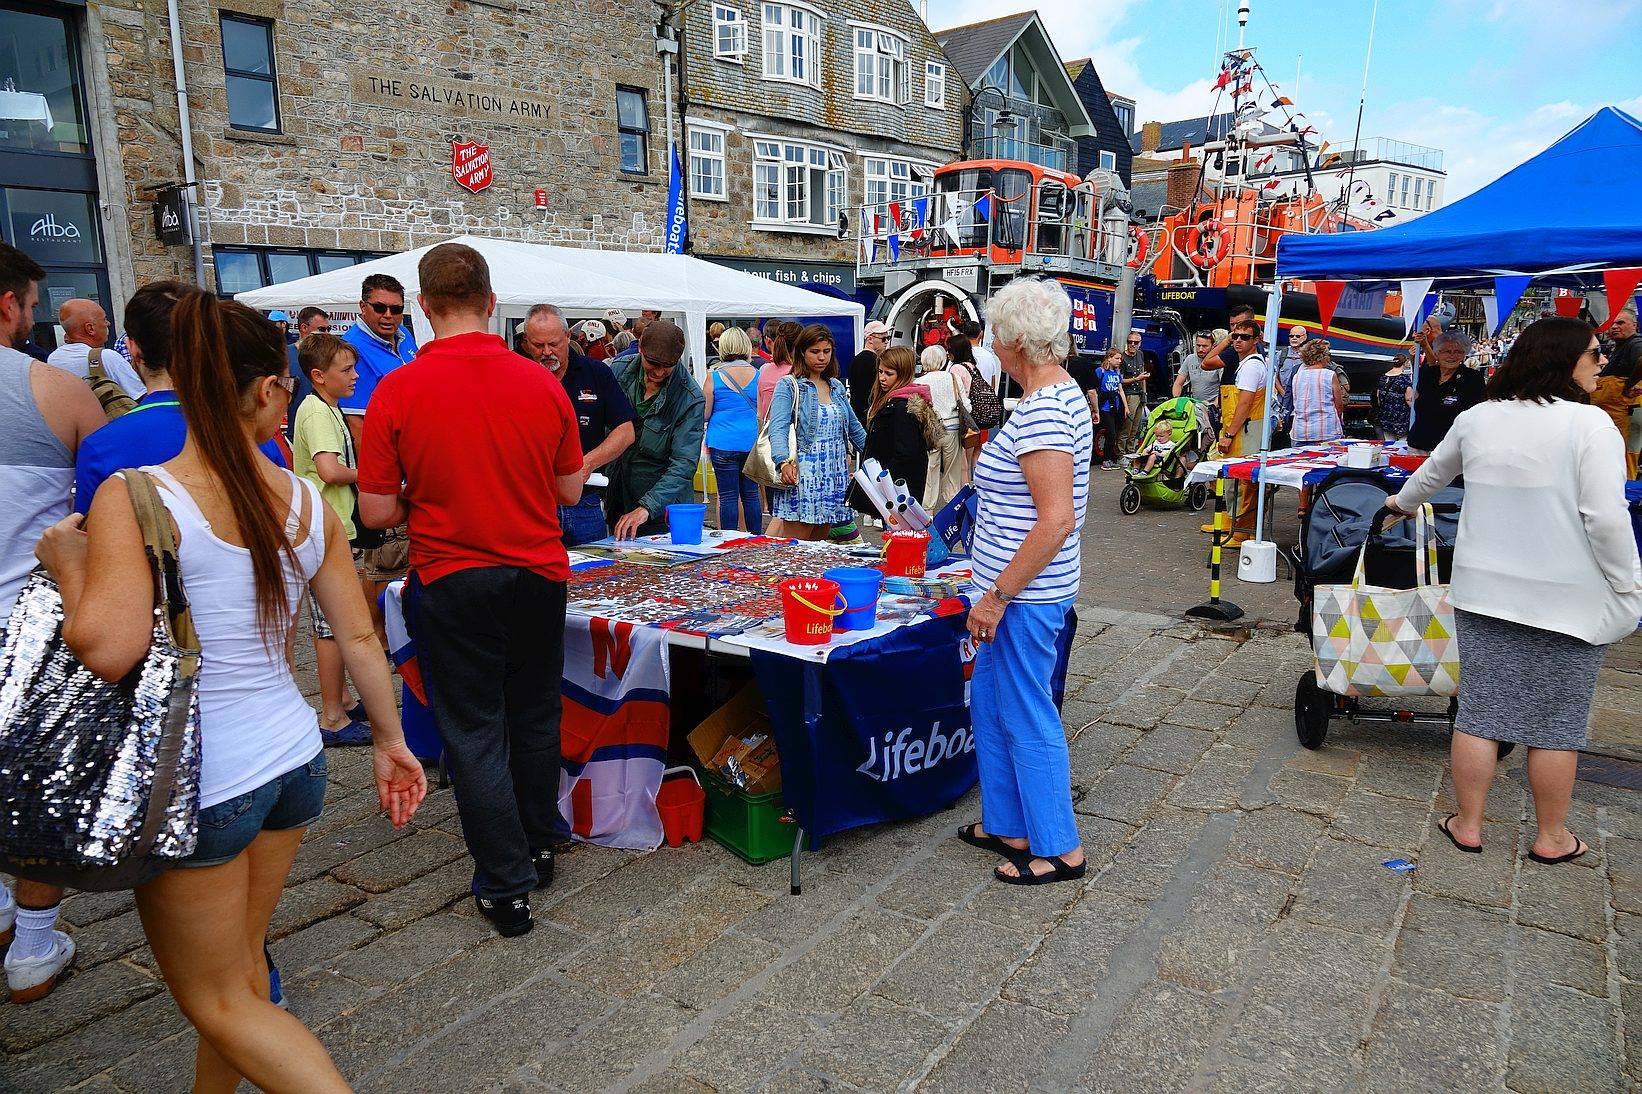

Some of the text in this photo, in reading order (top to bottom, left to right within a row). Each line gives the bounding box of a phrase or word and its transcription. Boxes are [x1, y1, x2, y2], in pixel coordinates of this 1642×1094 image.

[368, 77, 551, 119] THE SALVATION ARMY
[459, 146, 477, 161] THE
[455, 150, 490, 178] SALVATION
[469, 164, 490, 186] ARMY
[775, 269, 797, 282] fish
[800, 270, 809, 282] &
[812, 272, 841, 285] chips
[946, 268, 974, 277] HF15 FRX
[1161, 292, 1197, 300] LIFEBOAT
